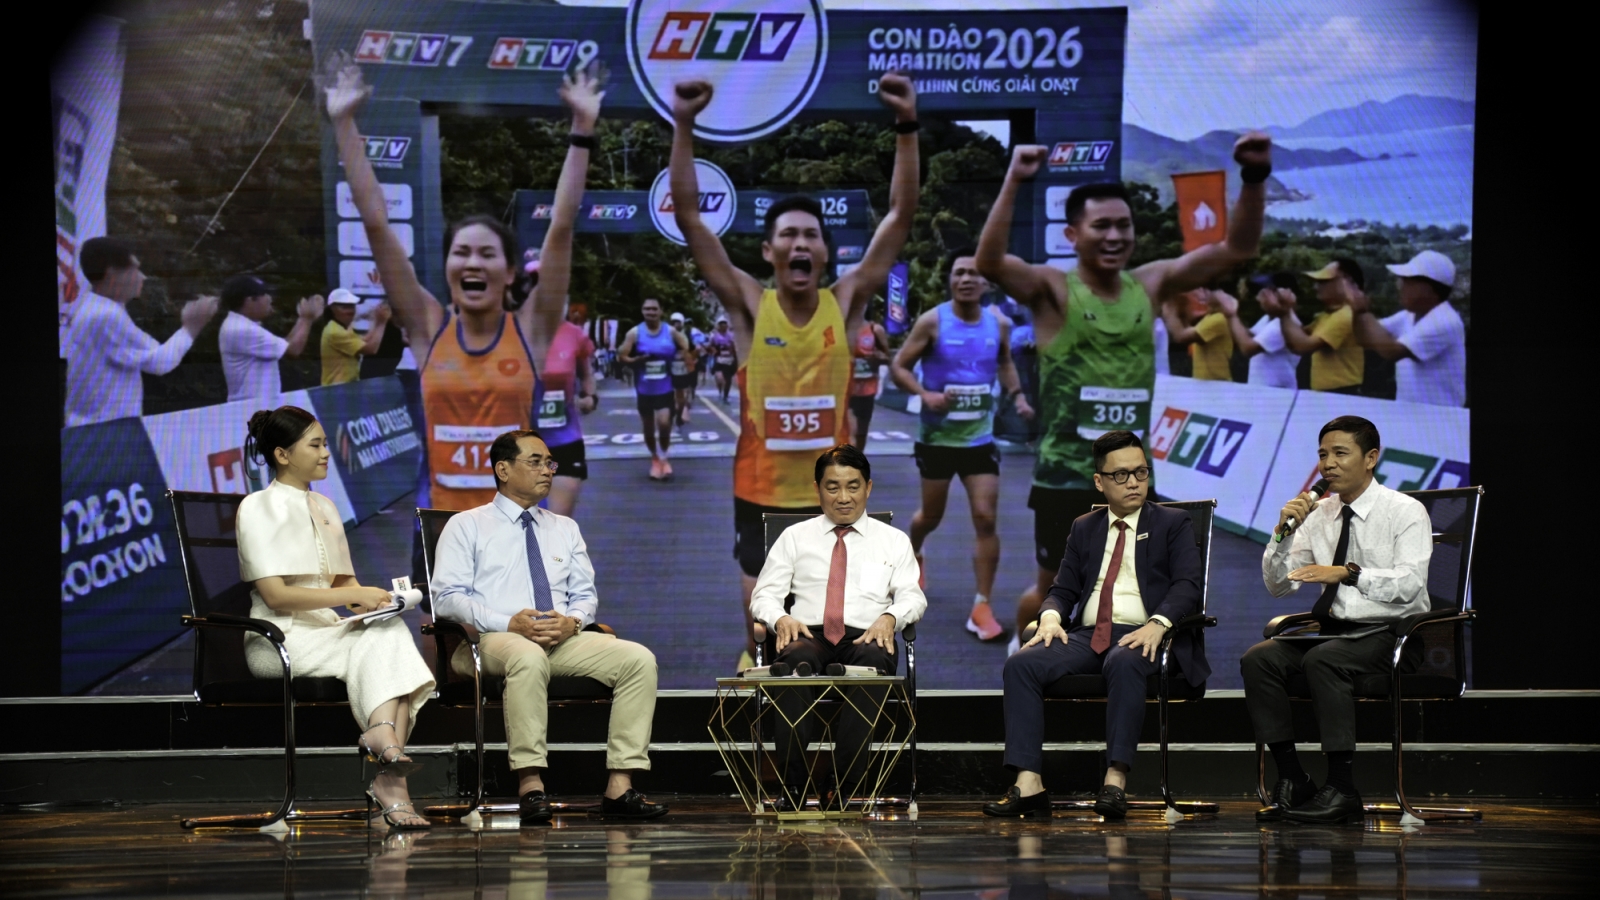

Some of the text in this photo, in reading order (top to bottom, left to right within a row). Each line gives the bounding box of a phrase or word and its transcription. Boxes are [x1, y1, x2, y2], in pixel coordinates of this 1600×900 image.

[356, 31, 473, 67] HTV7
[652, 13, 803, 61] HTV
[868, 27, 922, 50] CON
[983, 26, 1083, 69] 2026
[488, 37, 598, 70] HTV9
[362, 138, 410, 161] TV
[1049, 142, 1112, 164] HTV
[589, 204, 637, 220] HTV9
[779, 412, 820, 433] 395
[1093, 403, 1137, 424] 306
[1151, 408, 1250, 476] HTV
